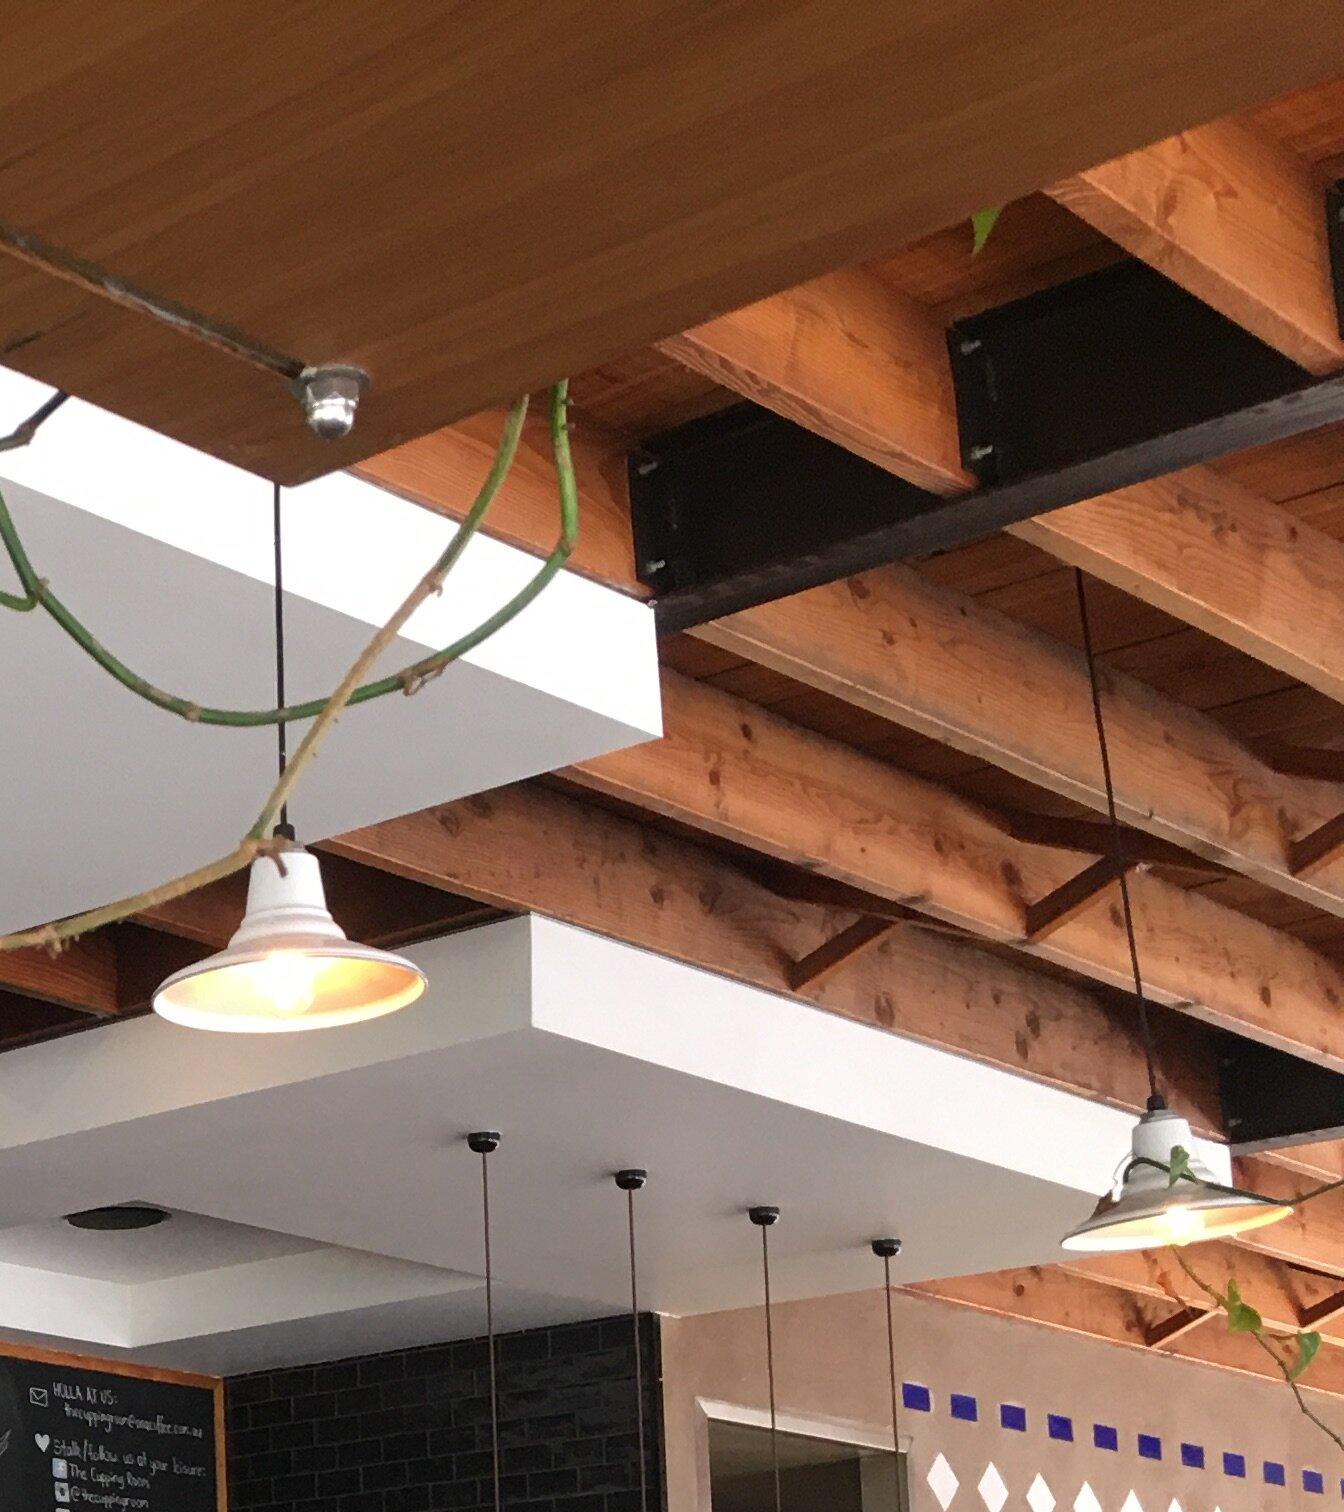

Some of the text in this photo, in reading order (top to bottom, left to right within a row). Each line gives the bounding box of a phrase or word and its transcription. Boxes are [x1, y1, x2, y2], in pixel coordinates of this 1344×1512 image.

[52, 1381, 118, 1406] HOLLA AT US:
[69, 1462, 151, 1490] The Cupping Room
[136, 1450, 148, 1467] at
[150, 1459, 169, 1477] your
